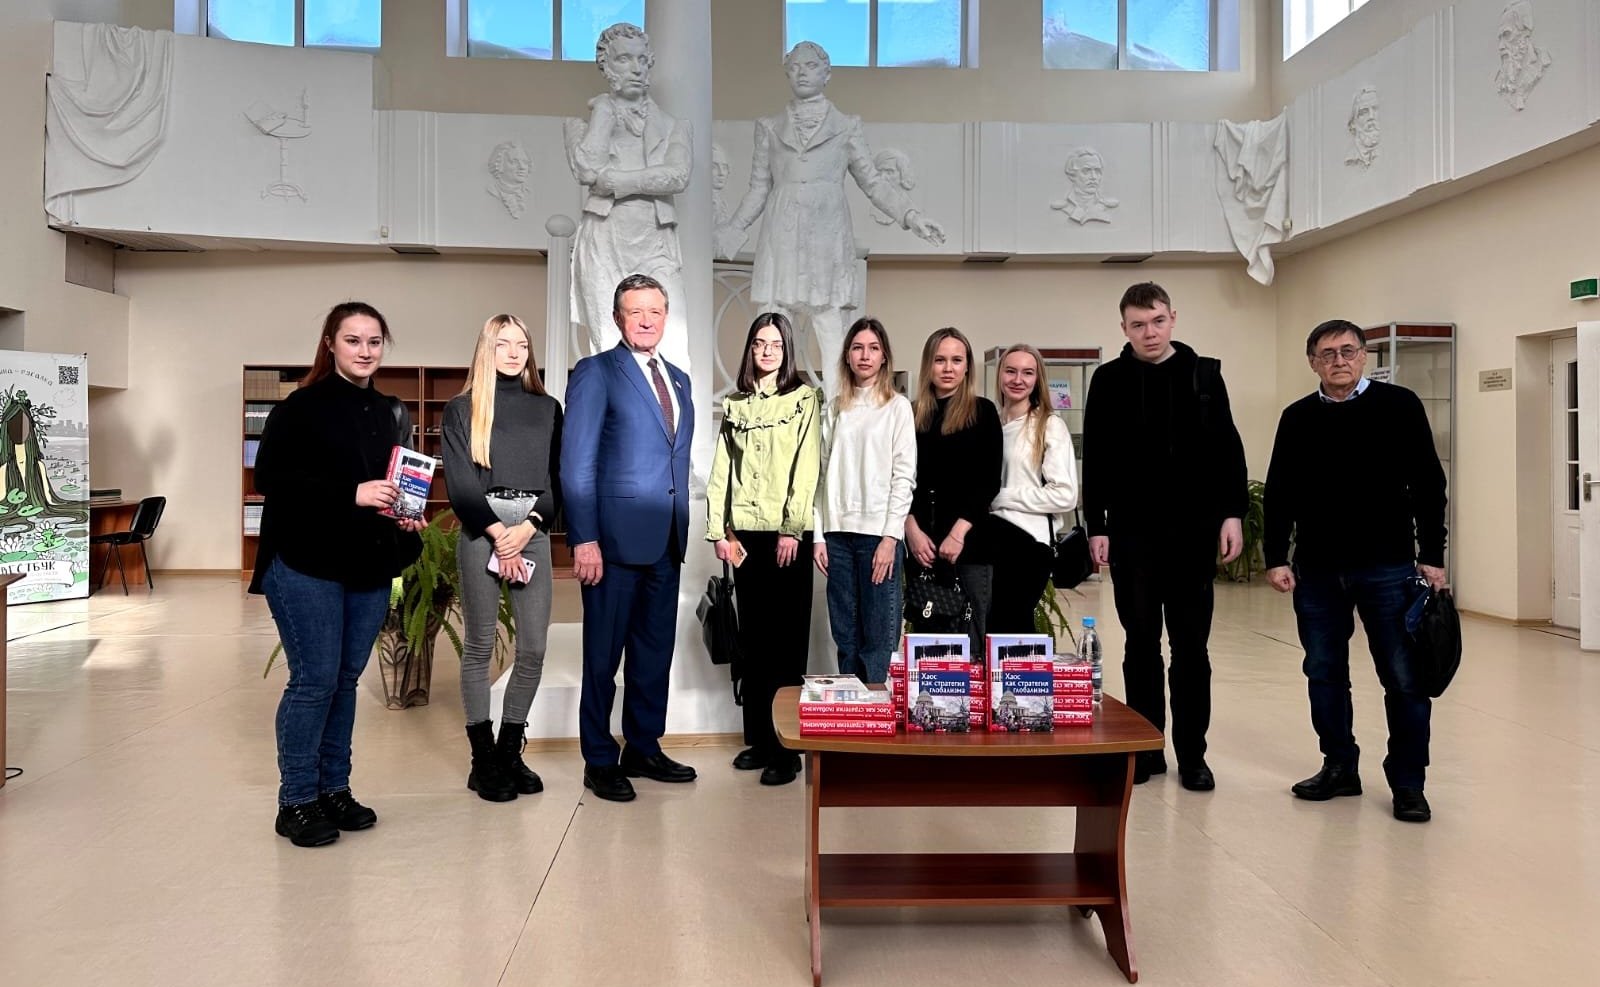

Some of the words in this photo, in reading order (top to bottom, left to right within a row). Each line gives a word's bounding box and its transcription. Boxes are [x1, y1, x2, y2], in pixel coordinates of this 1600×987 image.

[921, 672, 937, 680] Хаос
[1005, 672, 1021, 680] Хаос
[1013, 686, 1049, 694] глобализма
[877, 706, 891, 714] Хаос
